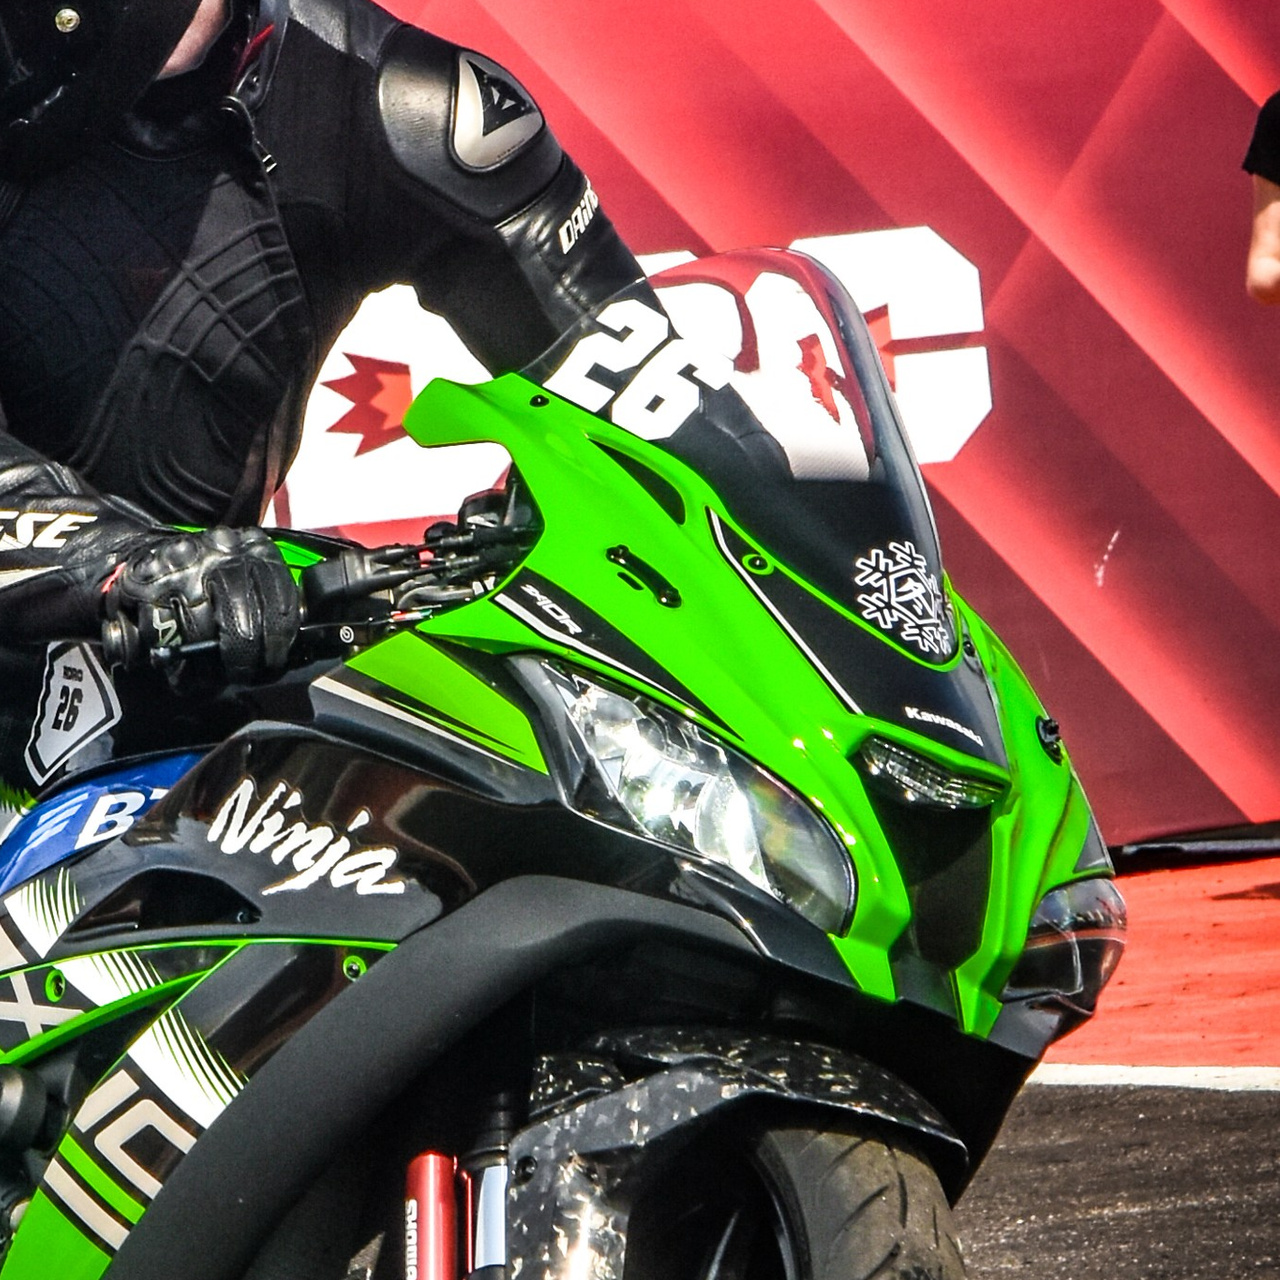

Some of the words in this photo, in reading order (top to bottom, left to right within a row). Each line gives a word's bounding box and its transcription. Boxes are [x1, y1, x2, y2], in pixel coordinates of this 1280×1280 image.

[542, 298, 730, 441] 26
[51, 685, 83, 732] 26
[904, 706, 984, 747] Kawasaki
[207, 779, 405, 895] Ninja
